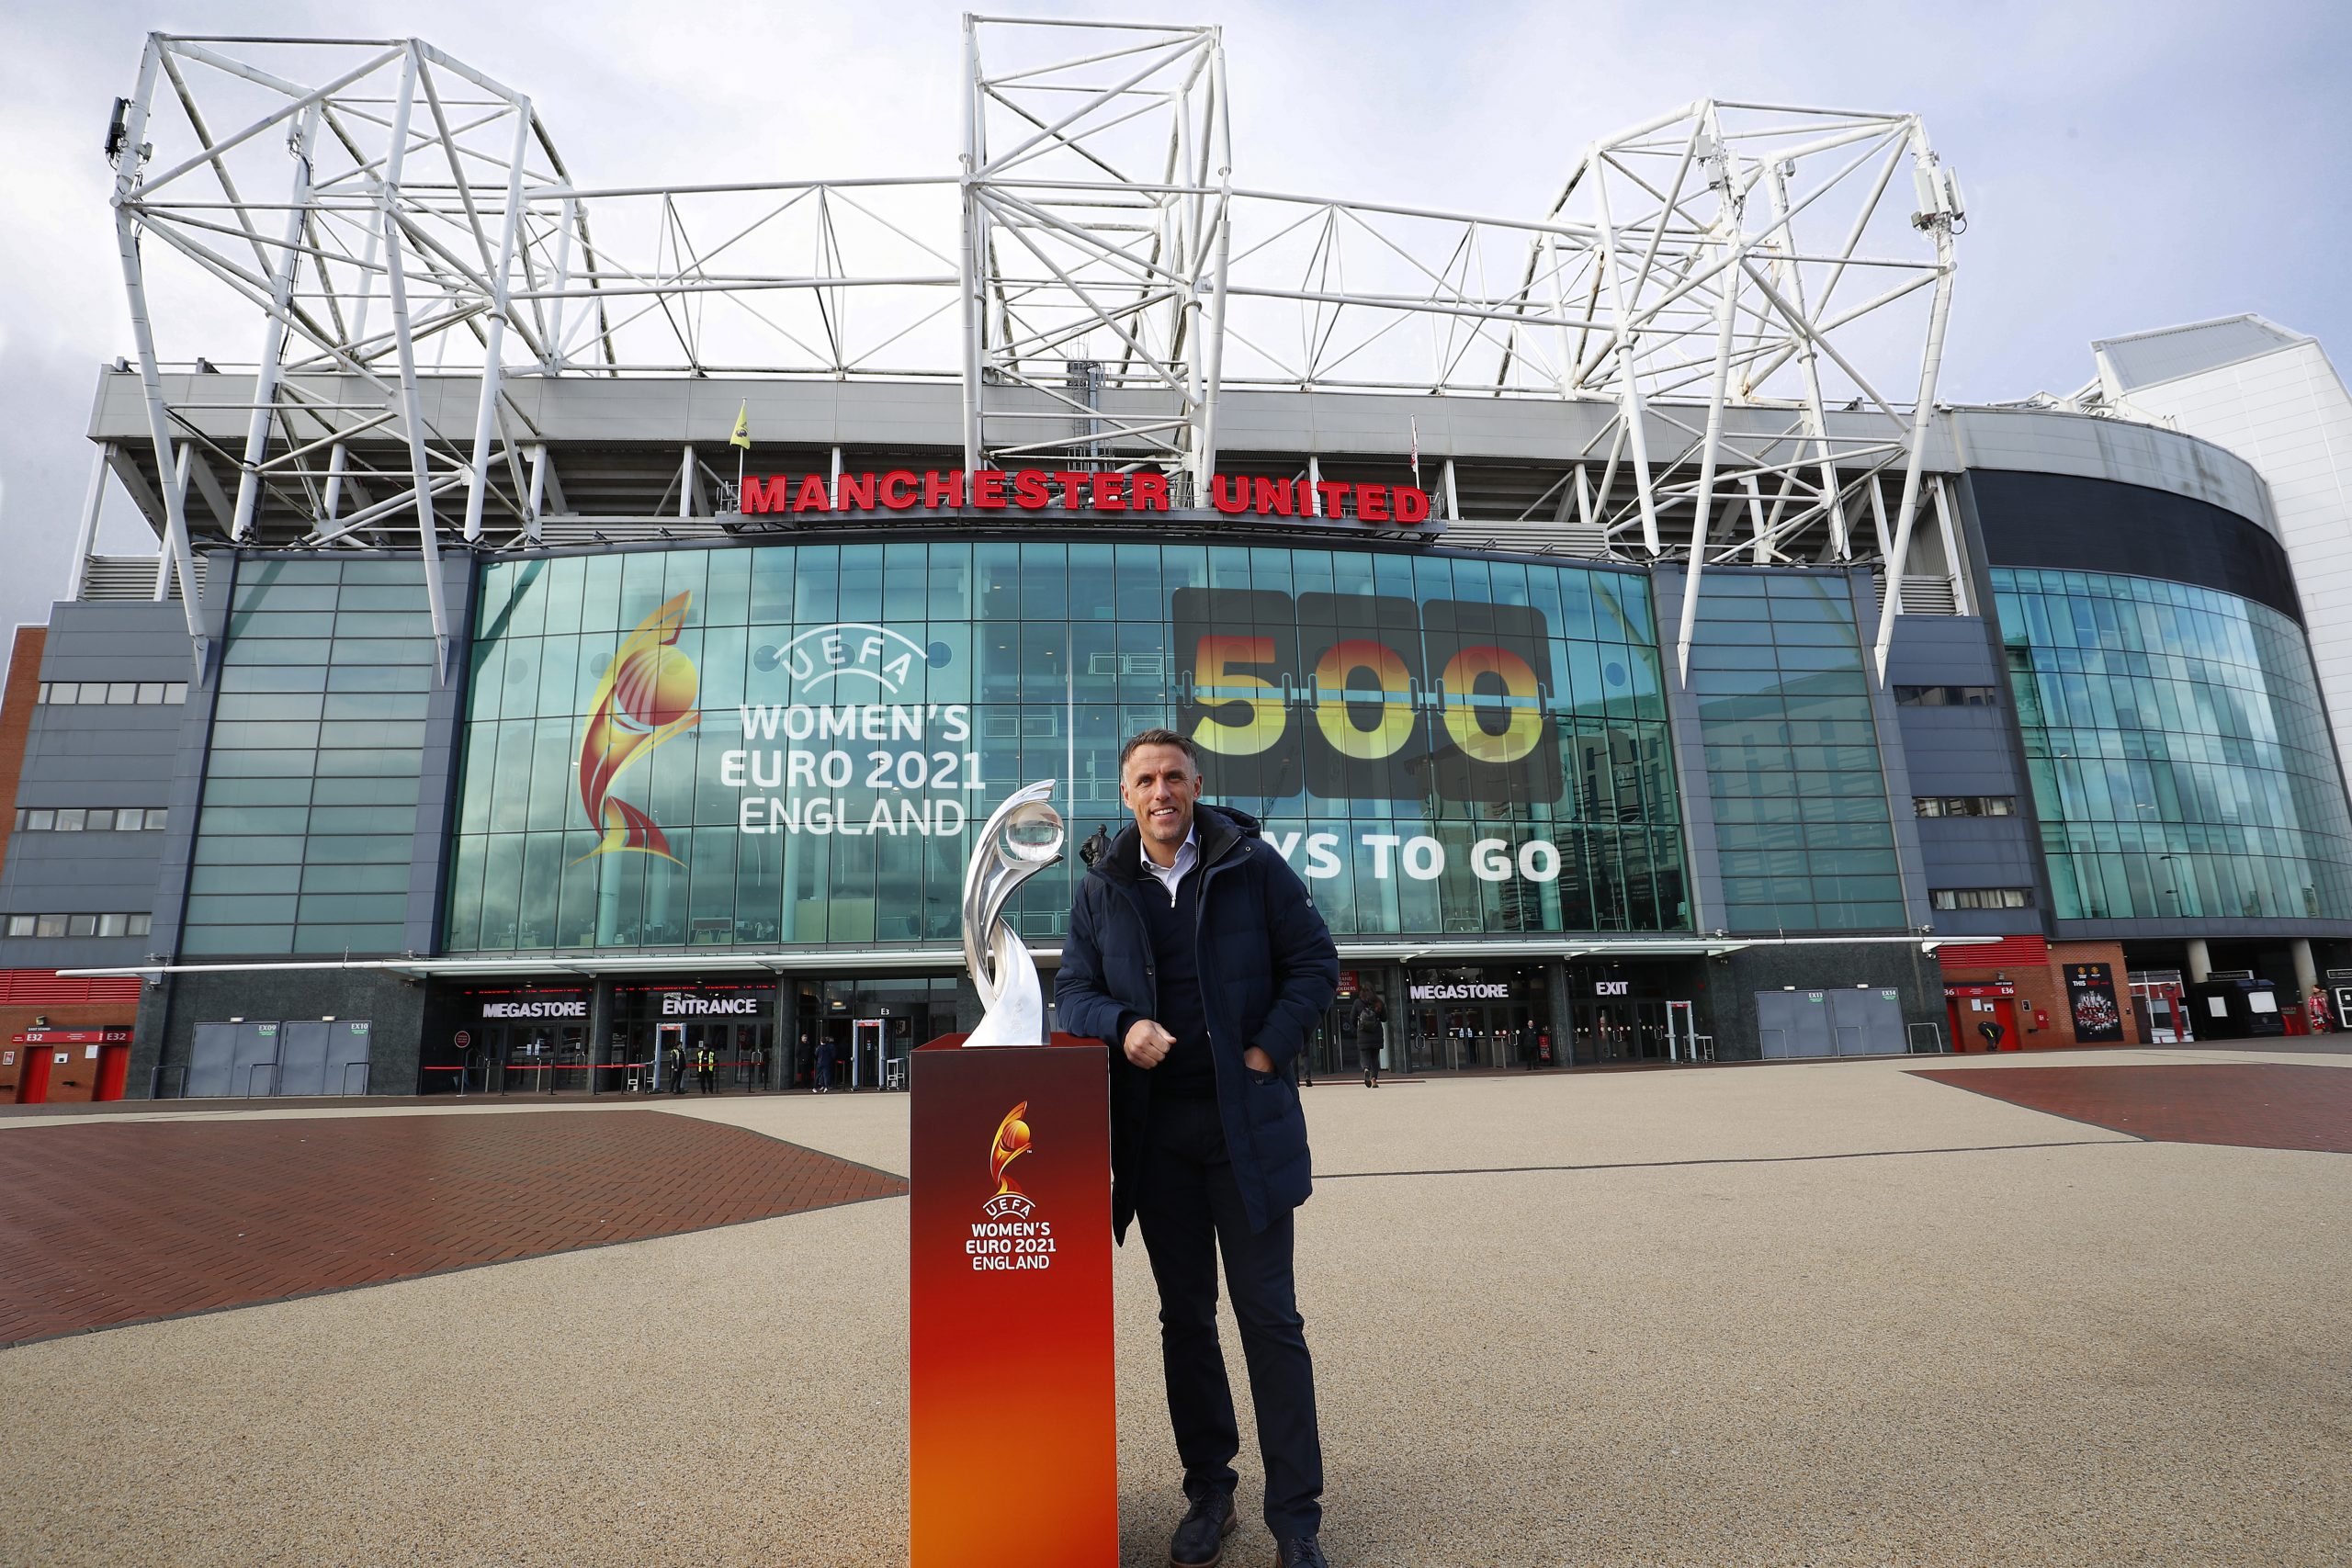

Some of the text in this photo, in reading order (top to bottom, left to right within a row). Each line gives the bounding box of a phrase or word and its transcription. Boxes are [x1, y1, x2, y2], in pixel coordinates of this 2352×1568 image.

[741, 470, 1430, 523] MANCHESTER UNITED
[782, 634, 911, 685] UEFA
[1192, 635, 1544, 763] 500
[740, 704, 970, 741] WOMEN'S
[720, 750, 986, 789] EURO 2021
[739, 797, 966, 837] ENGLAND
[1260, 830, 1561, 882] YS TO GO
[1410, 984, 1509, 999] MEGASTORE
[1596, 982, 1628, 995] EXIT
[482, 1002, 586, 1018] MEGASTORE
[662, 998, 758, 1015] ENTRANCE
[986, 1199, 1030, 1216] UEFA
[971, 1223, 1050, 1236] WOMEN'S
[966, 1238, 1056, 1254] EURO 2021
[973, 1256, 1049, 1270] ENGLAND
